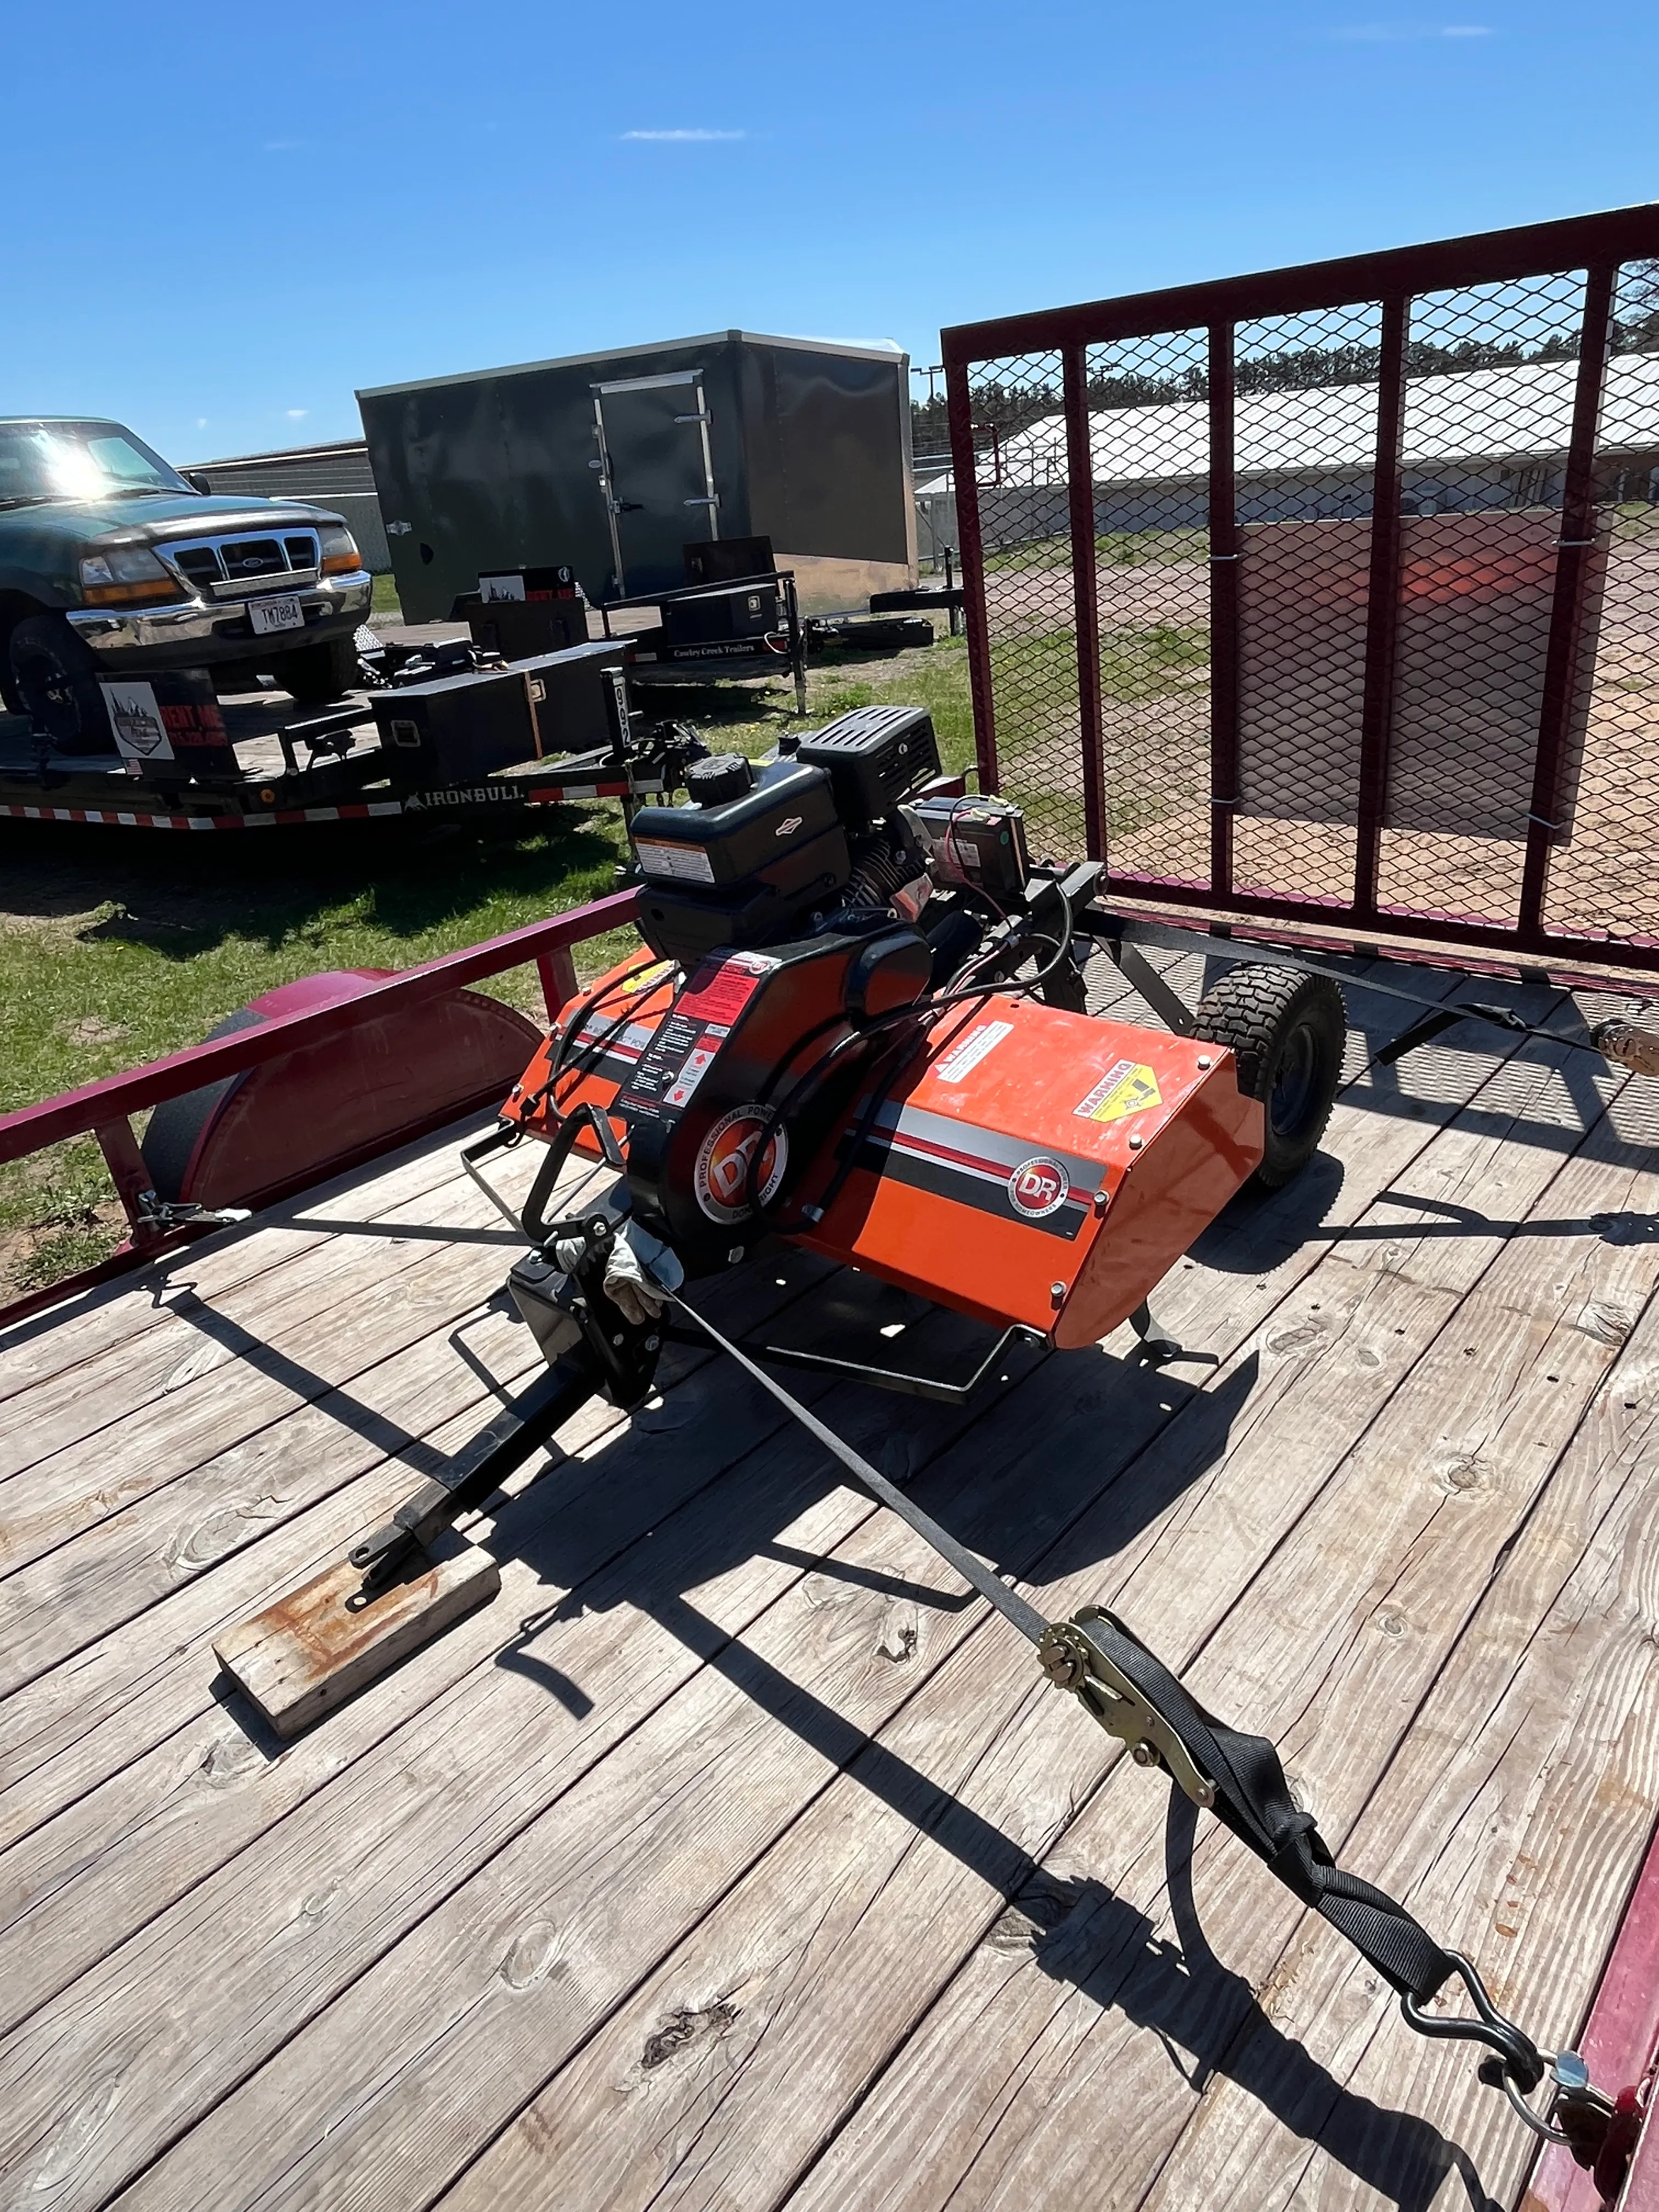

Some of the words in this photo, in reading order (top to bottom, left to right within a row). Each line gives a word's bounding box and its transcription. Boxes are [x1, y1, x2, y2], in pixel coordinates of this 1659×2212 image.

[1077, 1063, 1132, 1114] WARNING
[699, 1109, 743, 1188] PROFESSIONAL
[747, 1105, 775, 1121] POWE
[1018, 1172, 1057, 1201] DR
